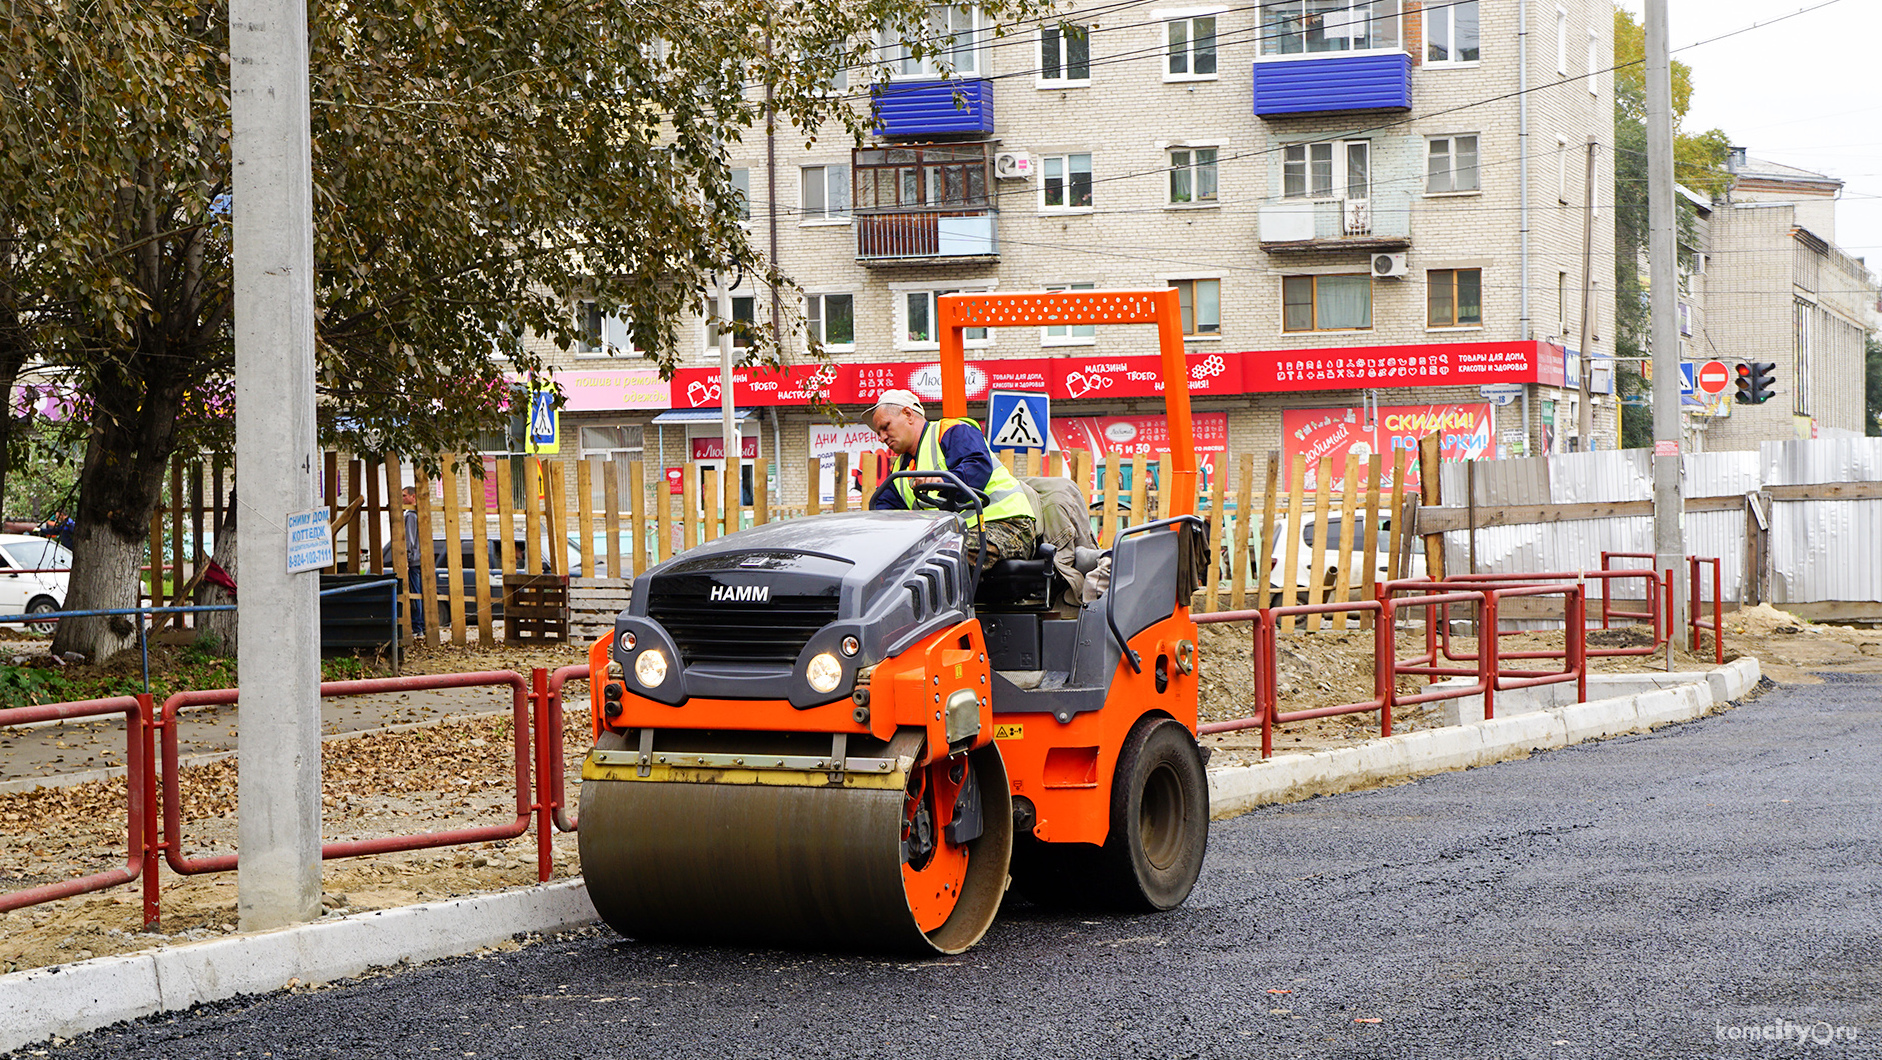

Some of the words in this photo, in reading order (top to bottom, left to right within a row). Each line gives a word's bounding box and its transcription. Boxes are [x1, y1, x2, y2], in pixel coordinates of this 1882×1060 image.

[1458, 353, 1487, 362] ТОВАРЫ
[1488, 352, 1504, 362] ДЛЯ
[1505, 352, 1527, 362] ДОМА,
[1085, 363, 1127, 374] МАГАЗИНЫ
[1458, 364, 1487, 373] КРАСОТЫ
[1494, 363, 1528, 372] ЗДОРОВЬЯ
[1126, 371, 1156, 381] ТВОЕГО
[575, 377, 611, 388] пошив
[614, 377, 621, 387] и
[749, 381, 778, 392] ТВОЕГО
[623, 390, 668, 403] одежды
[1385, 412, 1474, 432] СКИДКИ!
[815, 433, 838, 448] ДНИ
[1391, 434, 1488, 452] ПОРКИ!
[1108, 443, 1123, 455] 15
[1136, 443, 1151, 454] 30
[288, 513, 311, 528] СНИМУ
[292, 525, 326, 542] КОТТЕДЖ
[710, 586, 769, 602] HAMM
